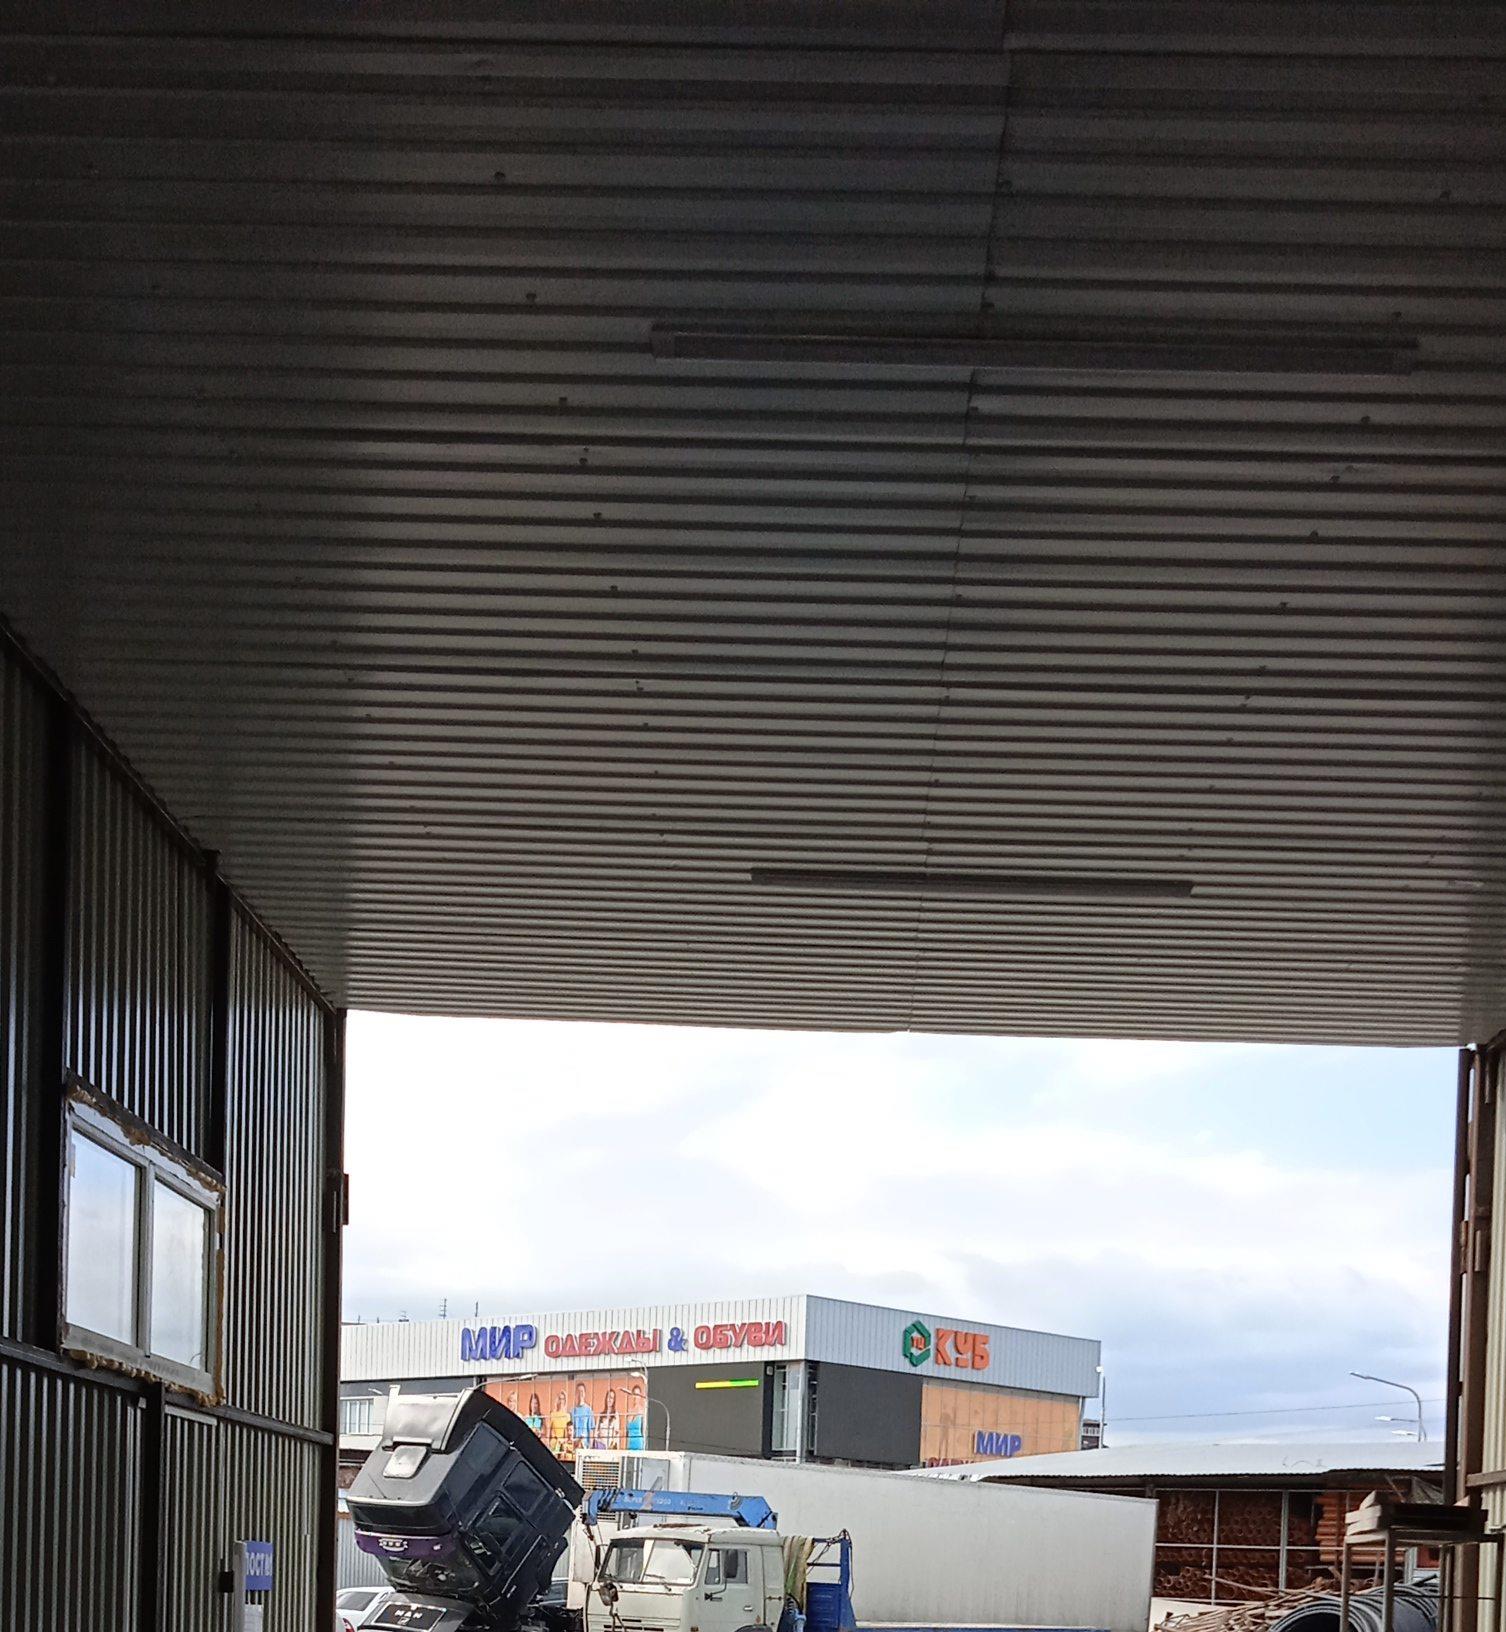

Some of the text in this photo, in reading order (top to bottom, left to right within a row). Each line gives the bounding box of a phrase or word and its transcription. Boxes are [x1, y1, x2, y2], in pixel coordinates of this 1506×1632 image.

[461, 1320, 786, 1361] МИР ОДЕЖДЫ & ОБУВИ
[935, 1327, 990, 1370] КУБ
[974, 1429, 1022, 1457] МИР
